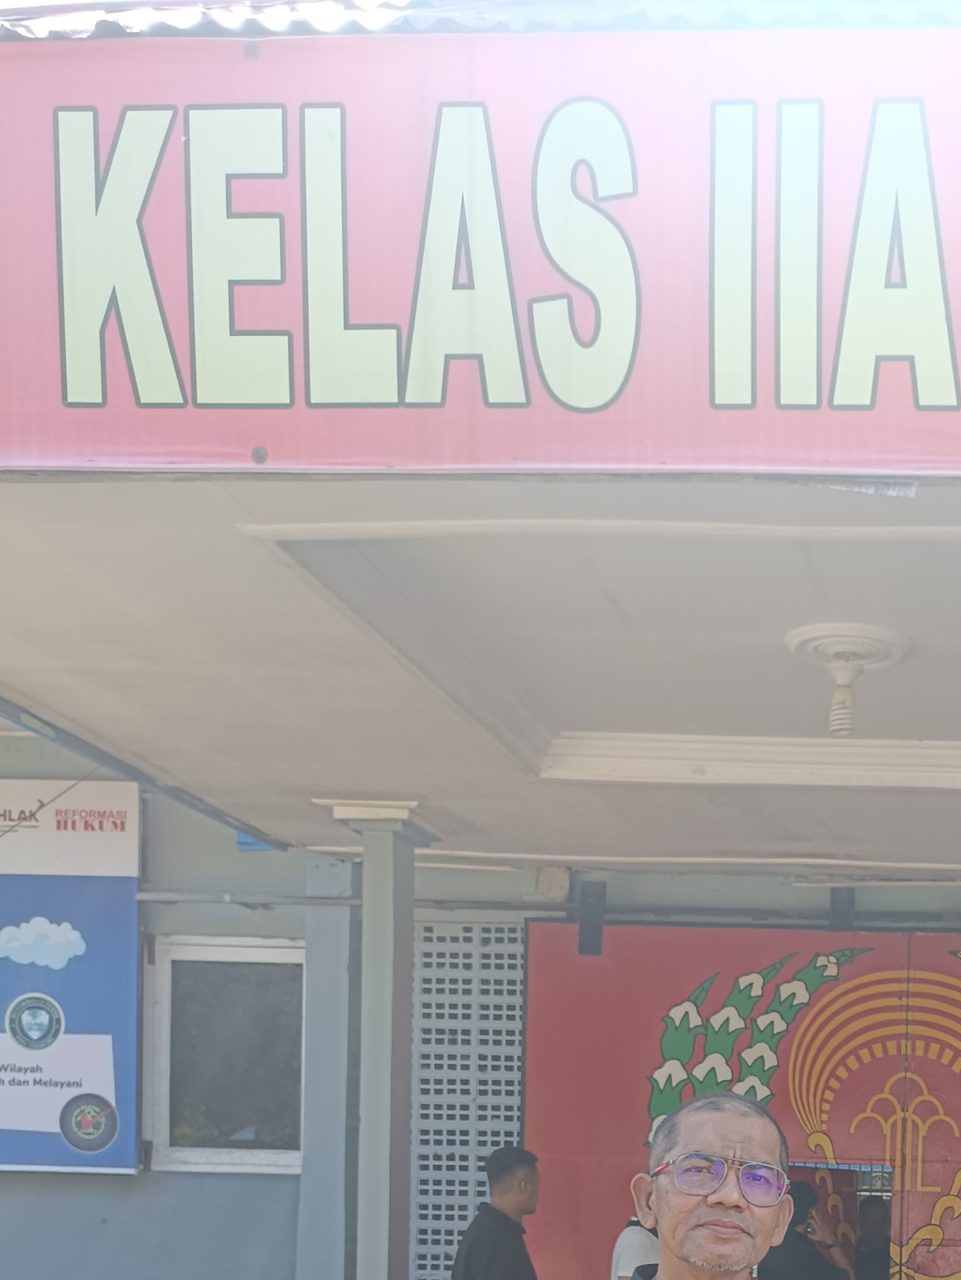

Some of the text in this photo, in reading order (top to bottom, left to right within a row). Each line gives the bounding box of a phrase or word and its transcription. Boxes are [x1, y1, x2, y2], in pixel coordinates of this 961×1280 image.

[54, 96, 641, 412] KELAS
[710, 98, 961, 410] IIA
[55, 809, 127, 820] REFORMASI
[56, 819, 126, 832] HUKUM
[8, 1078, 29, 1086] dan
[33, 1077, 83, 1089] Melayani
